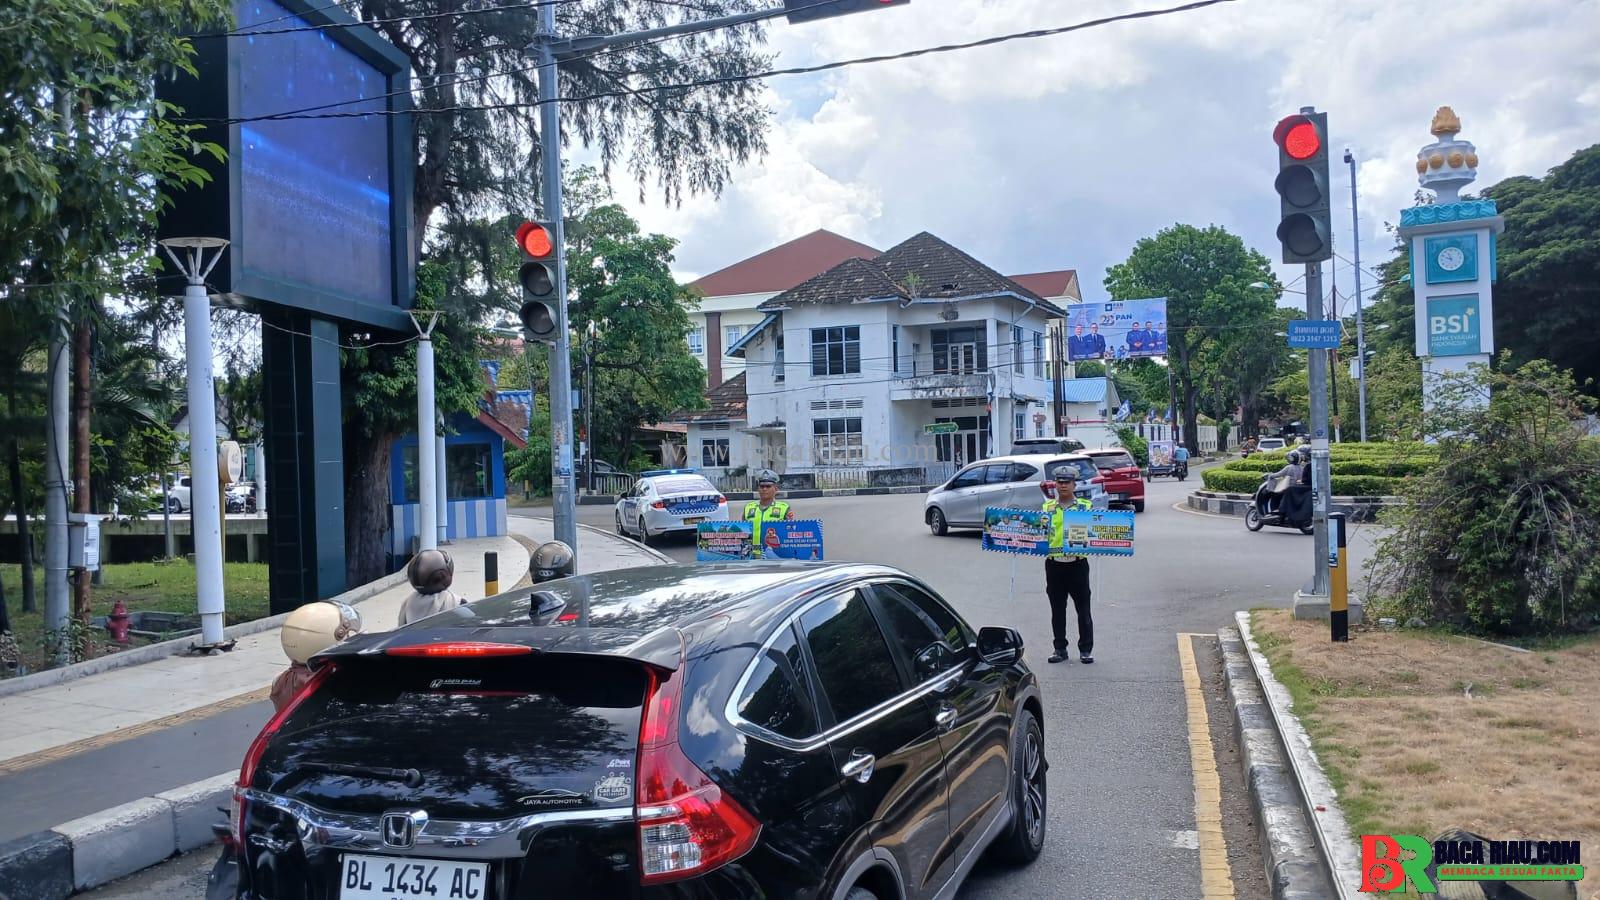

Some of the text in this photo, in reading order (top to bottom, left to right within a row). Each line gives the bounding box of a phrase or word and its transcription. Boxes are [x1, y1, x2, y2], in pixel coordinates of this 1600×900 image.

[1431, 310, 1472, 335] BSI
[346, 859, 481, 899] BL 1434 AC
